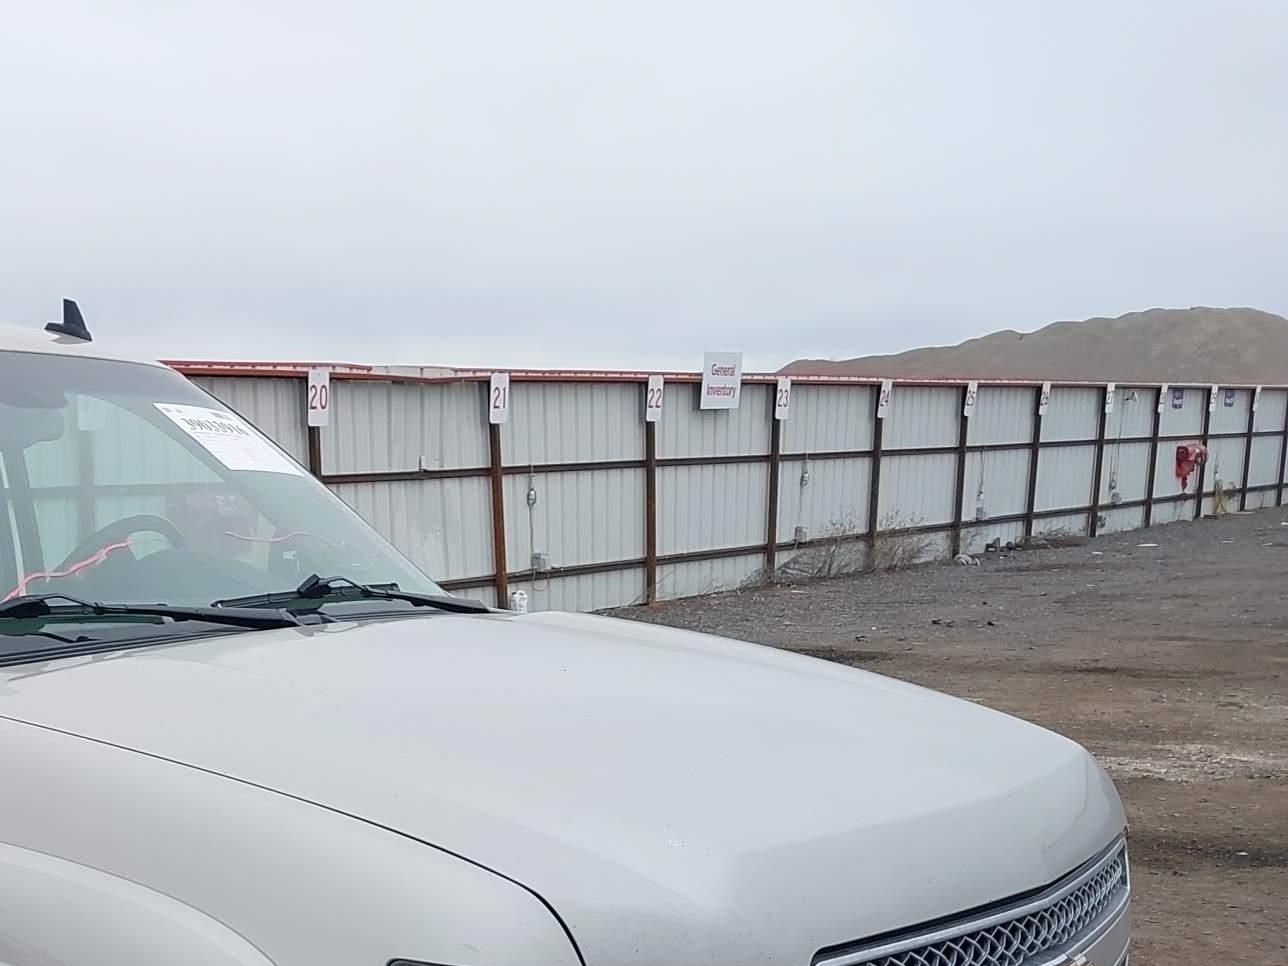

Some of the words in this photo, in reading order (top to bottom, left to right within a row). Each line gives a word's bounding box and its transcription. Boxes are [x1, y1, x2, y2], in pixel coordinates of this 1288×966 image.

[712, 363, 736, 377] General
[310, 384, 328, 410] 20
[493, 386, 506, 409] 21
[648, 388, 662, 409] 22
[707, 384, 736, 399] Inventory
[777, 388, 789, 408] 23
[880, 390, 890, 407] 24
